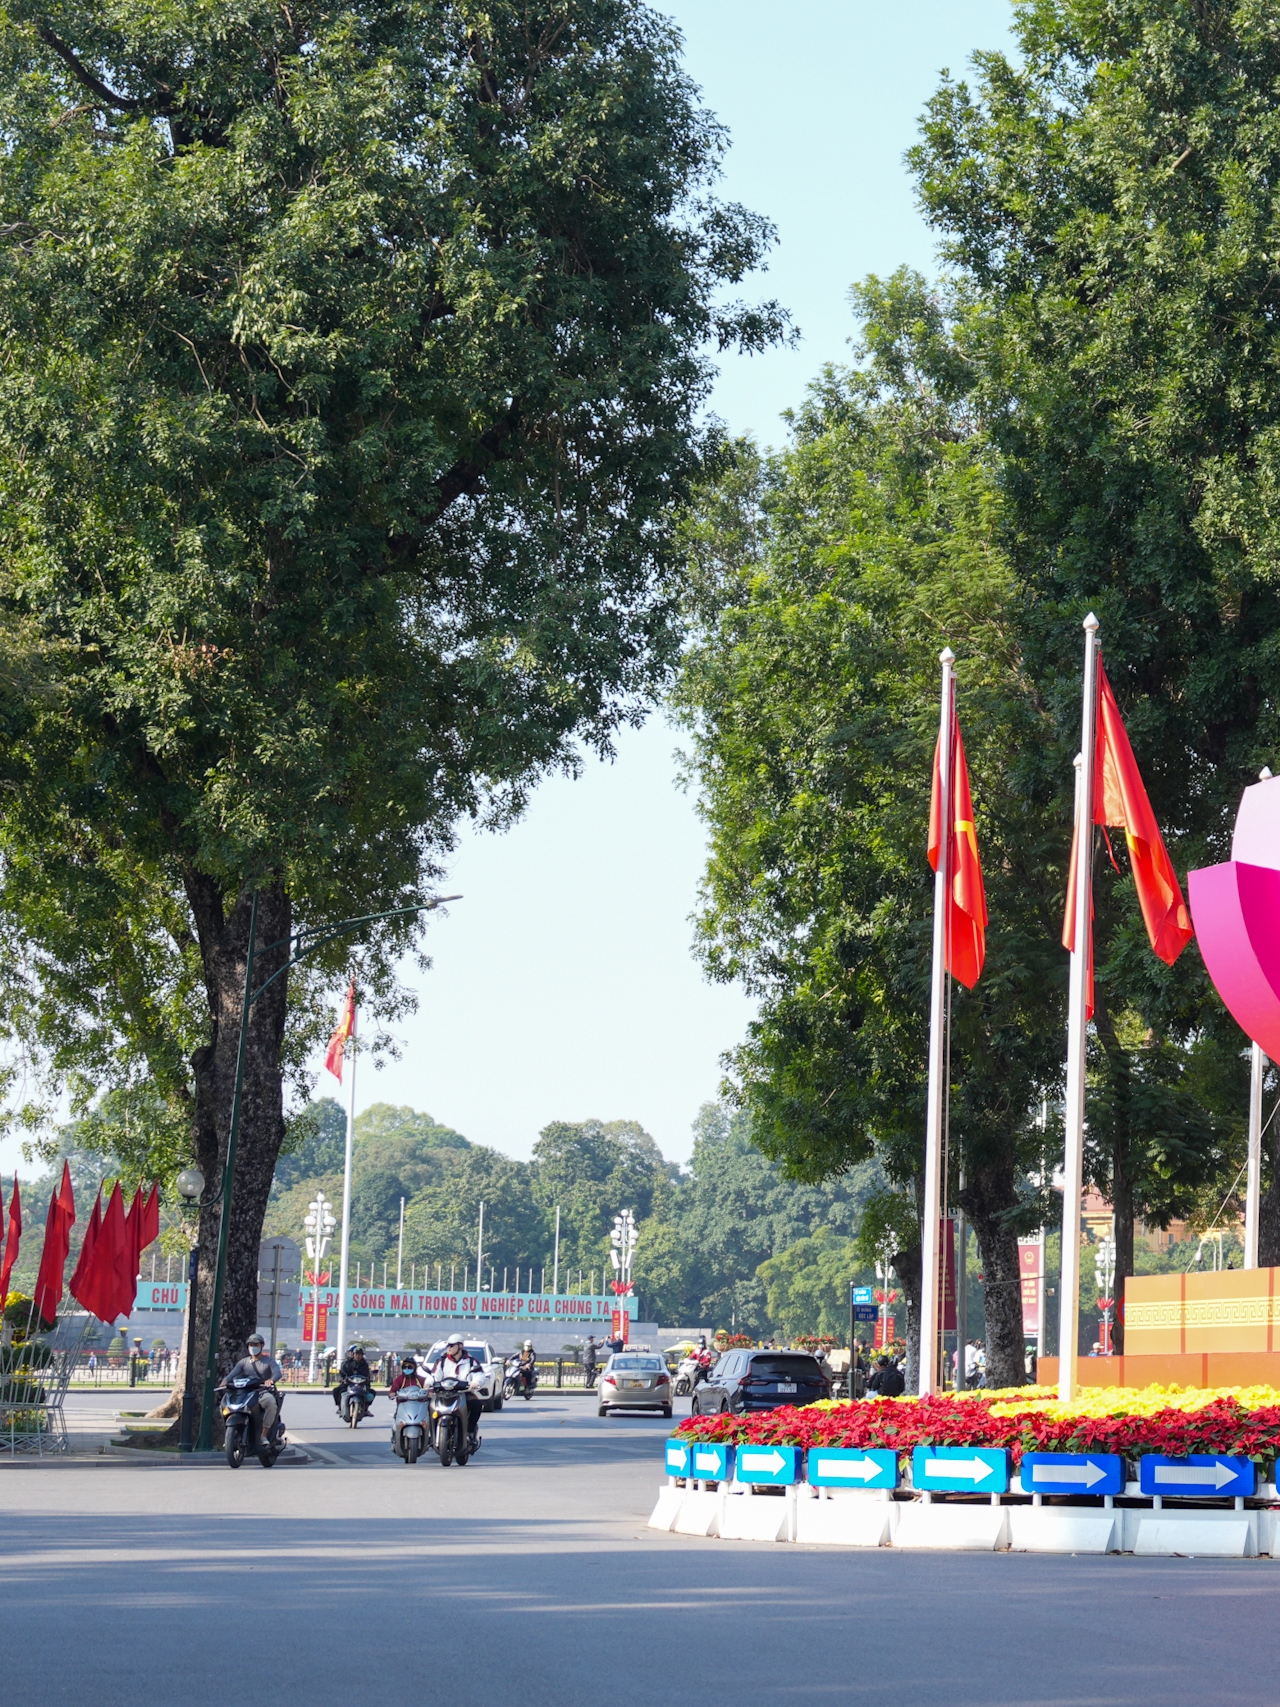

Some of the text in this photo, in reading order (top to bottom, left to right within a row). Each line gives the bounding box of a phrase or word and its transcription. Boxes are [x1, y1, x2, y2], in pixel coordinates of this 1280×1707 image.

[152, 1283, 179, 1304] CHỦ
[352, 1288, 385, 1309] SỐNG
[390, 1292, 413, 1310] MÃI
[418, 1295, 457, 1311] TRONG
[462, 1295, 478, 1314] SỰ
[482, 1295, 524, 1315] NGHIỆP
[528, 1294, 550, 1314] CỦA
[555, 1297, 592, 1315] CHÚNG
[597, 1301, 610, 1316] TA
